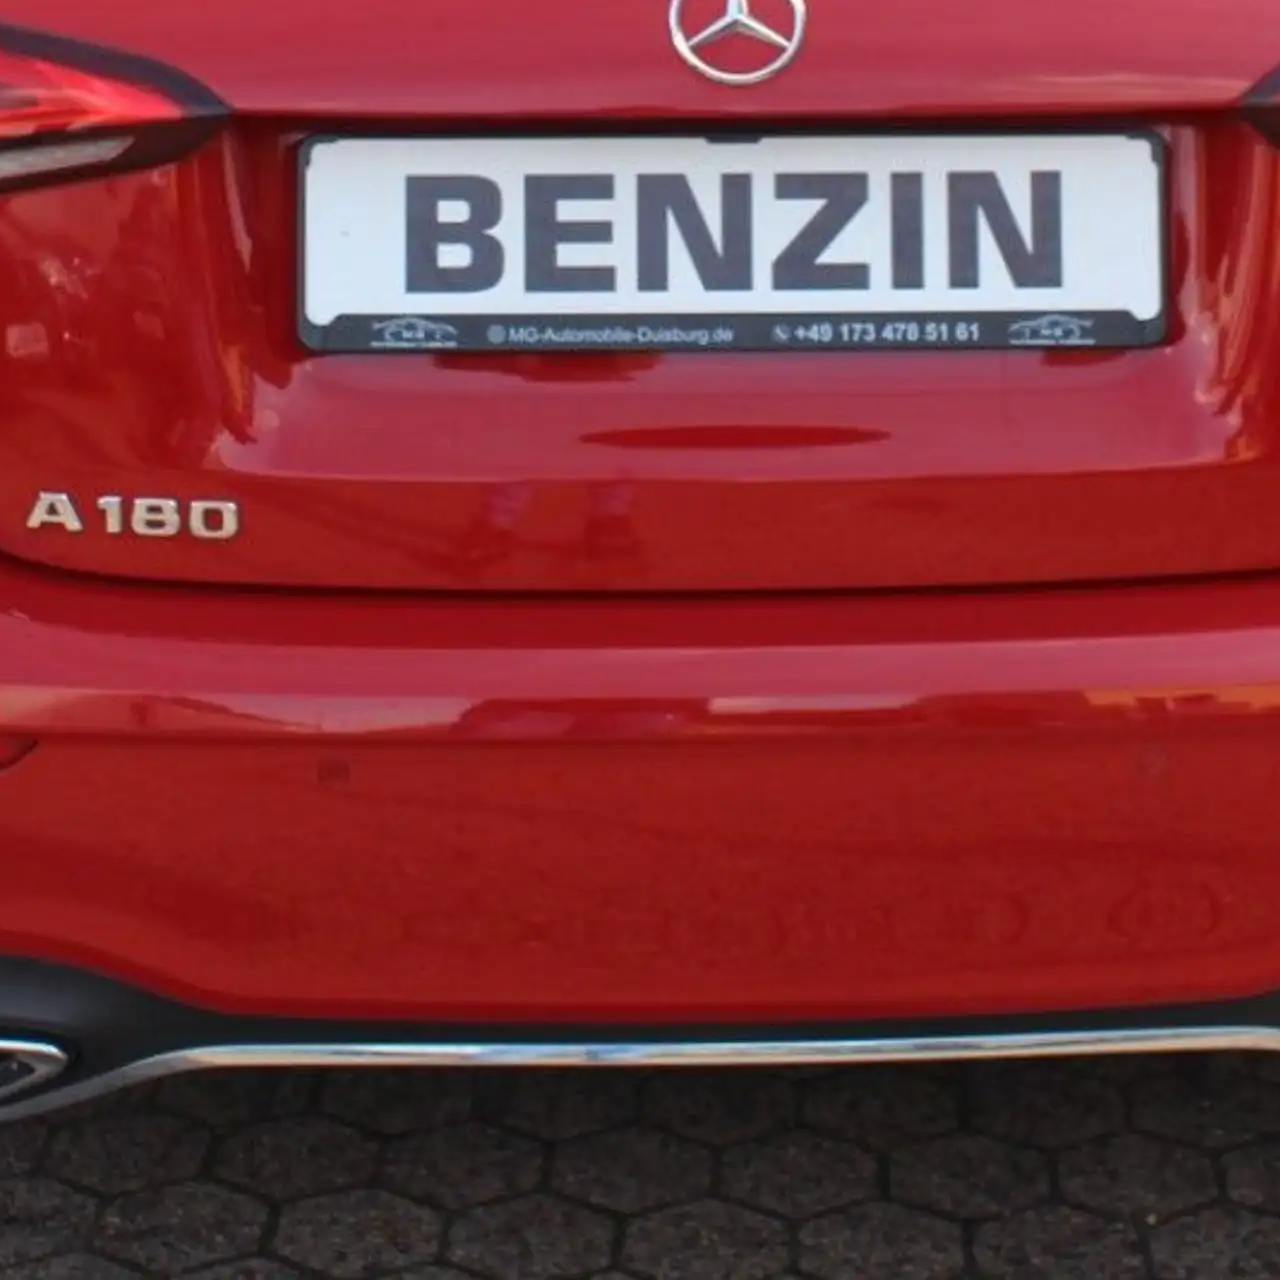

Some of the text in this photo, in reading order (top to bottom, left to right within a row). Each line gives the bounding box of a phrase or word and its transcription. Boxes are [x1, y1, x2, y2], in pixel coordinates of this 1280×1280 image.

[403, 169, 1065, 295] BENZIN
[794, 322, 833, 343] +49
[840, 322, 876, 342] 173
[924, 321, 949, 341] 51
[26, 491, 239, 539] A 180
